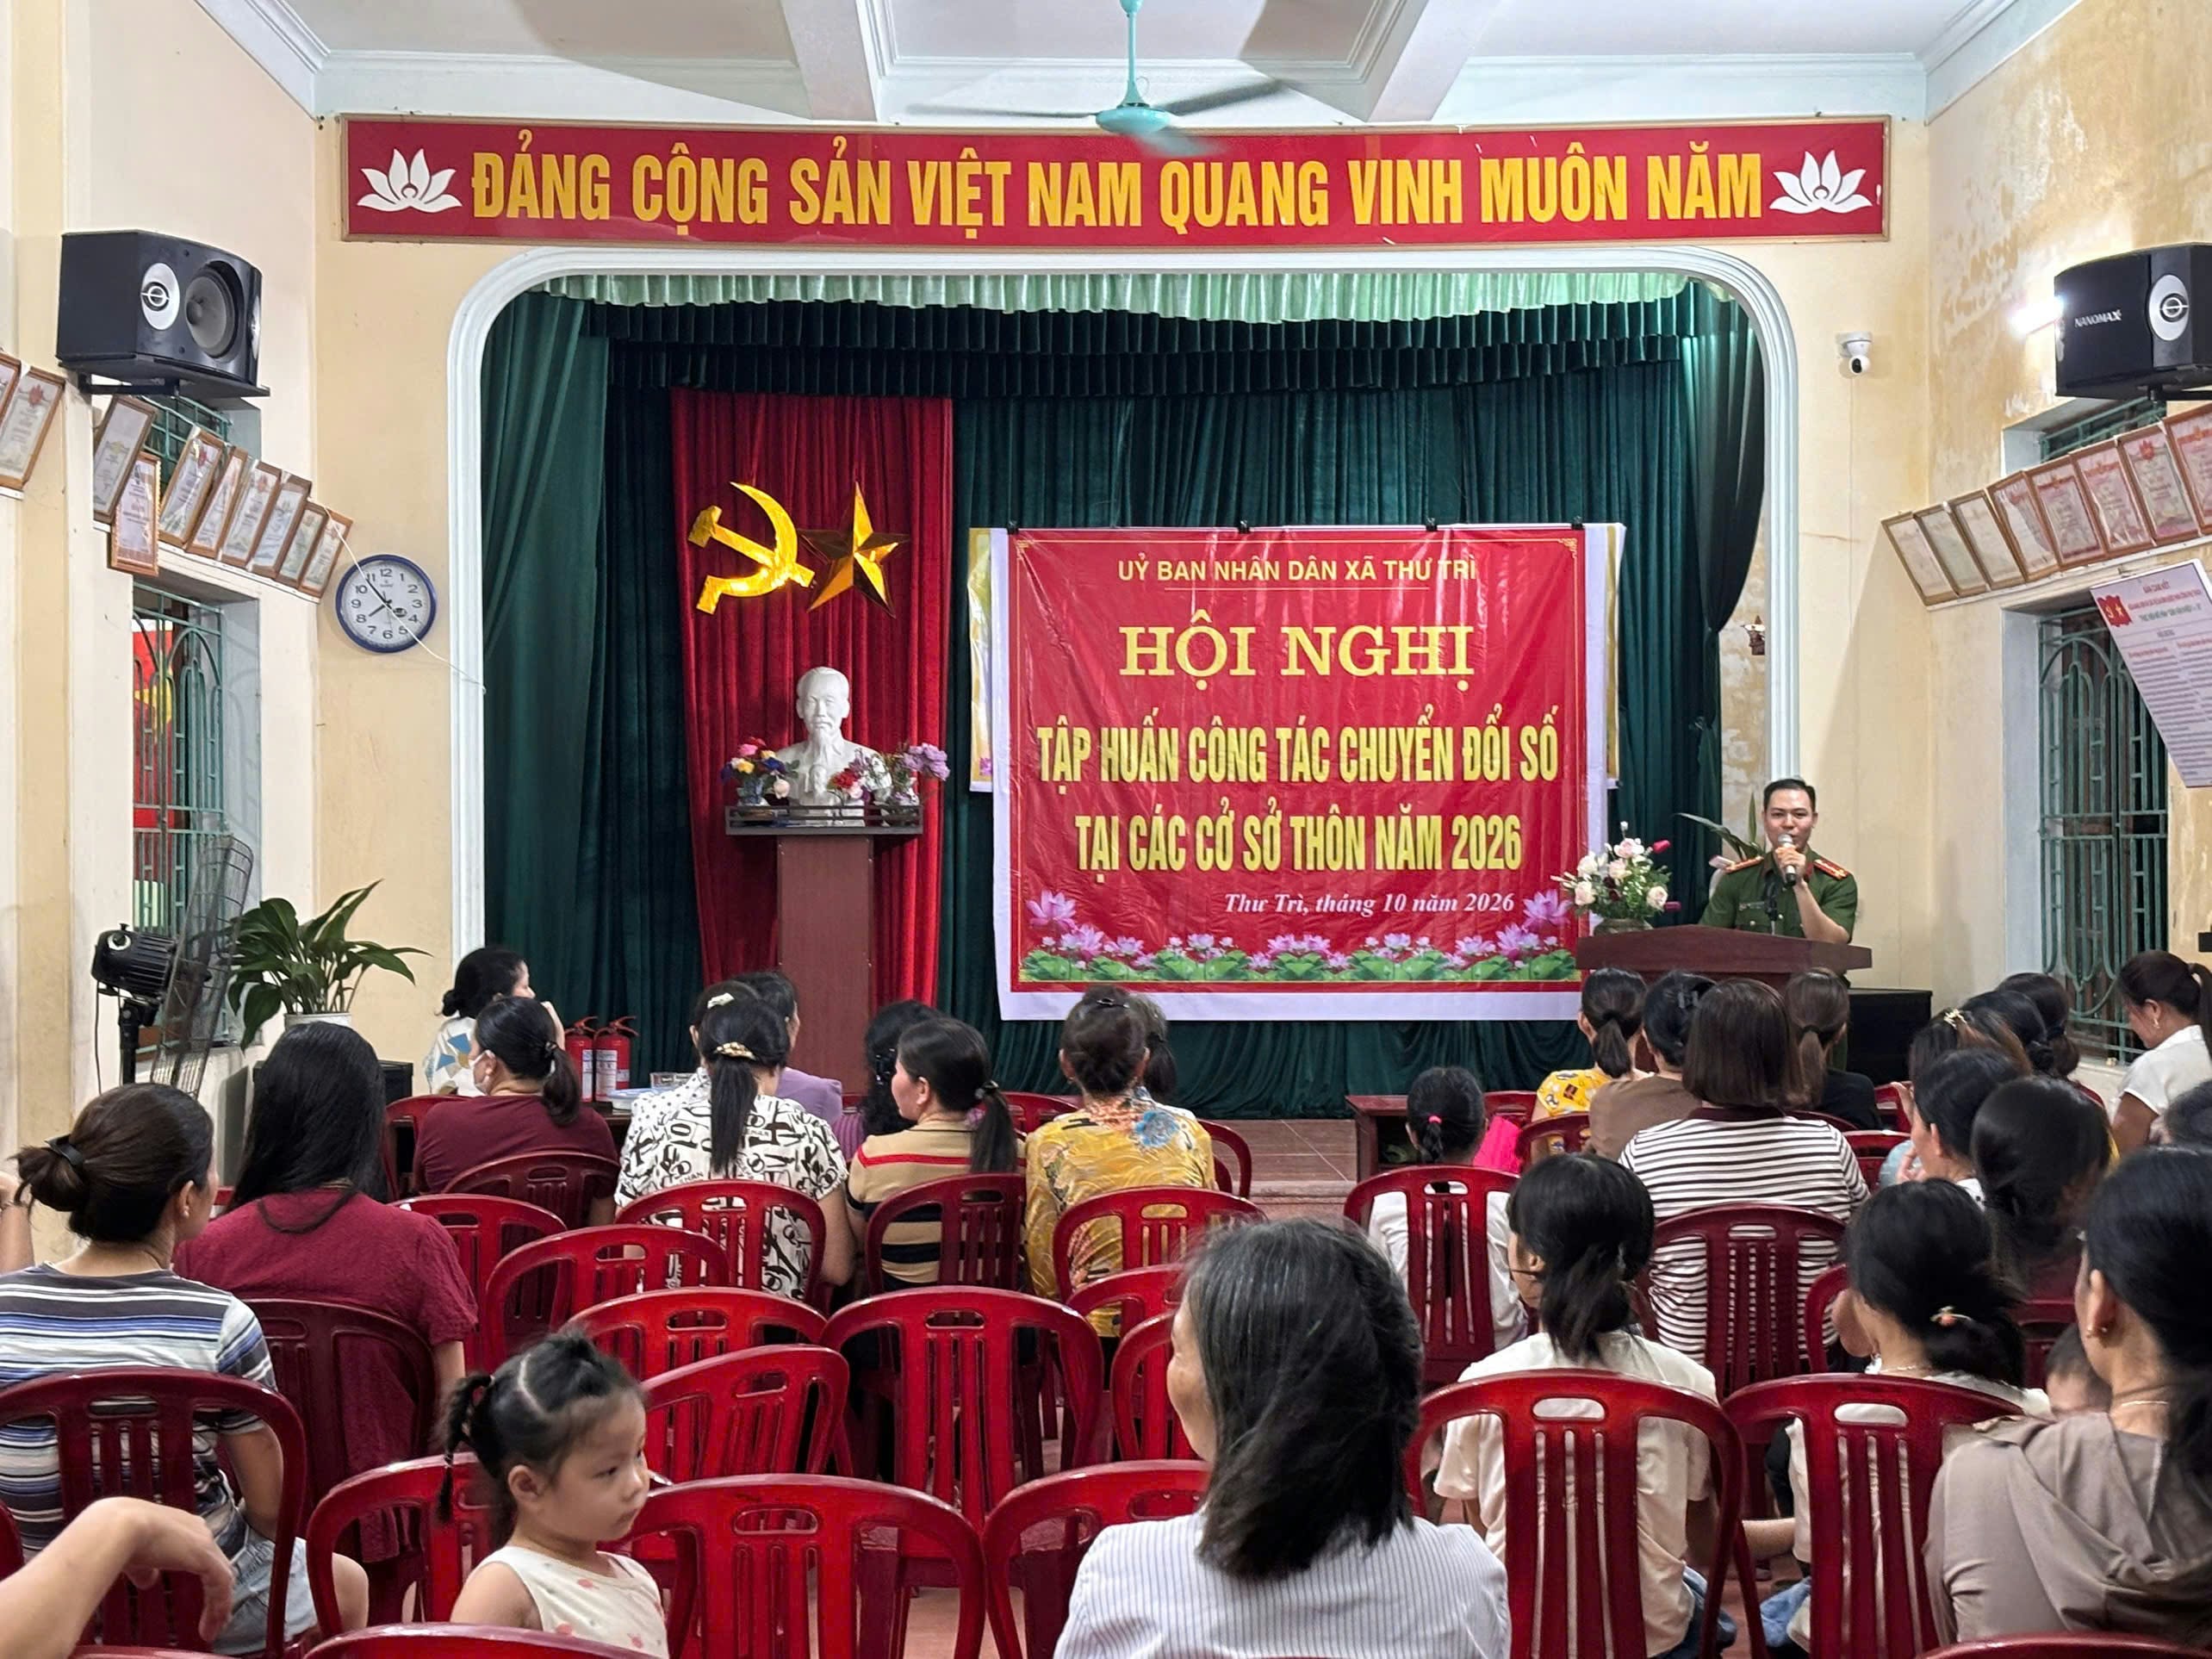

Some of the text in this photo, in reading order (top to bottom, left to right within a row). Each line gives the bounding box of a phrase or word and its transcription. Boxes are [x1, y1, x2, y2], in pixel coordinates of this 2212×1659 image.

[471, 129, 1762, 239] ĐẢNG CỘNG SẢN VIỆT NAM QUANG VINH MUÔN NĂM
[1118, 553, 1476, 581] UỶ BAN NHÂN DÂN XÃ THƯ TRÌ
[380, 569, 392, 577] 12
[355, 585, 367, 593] 10
[407, 584, 418, 593] 2
[351, 599, 361, 608] 9
[412, 599, 422, 607] 3
[356, 613, 366, 623] 8
[407, 614, 418, 623] 4
[367, 625, 376, 634] 7
[382, 630, 393, 638] 6
[1119, 608, 1475, 692] HỘI NGHỊ
[1036, 702, 1559, 795] TẬP HUẤN CÔNG TÁC CHUYỂN ĐỔI SỐ
[1074, 796, 1522, 884] TẠI CÁC CỞ SỞ THÔN NĂM 2026
[1225, 892, 1515, 918] Thư Trì, tháng 10 năm 2026
